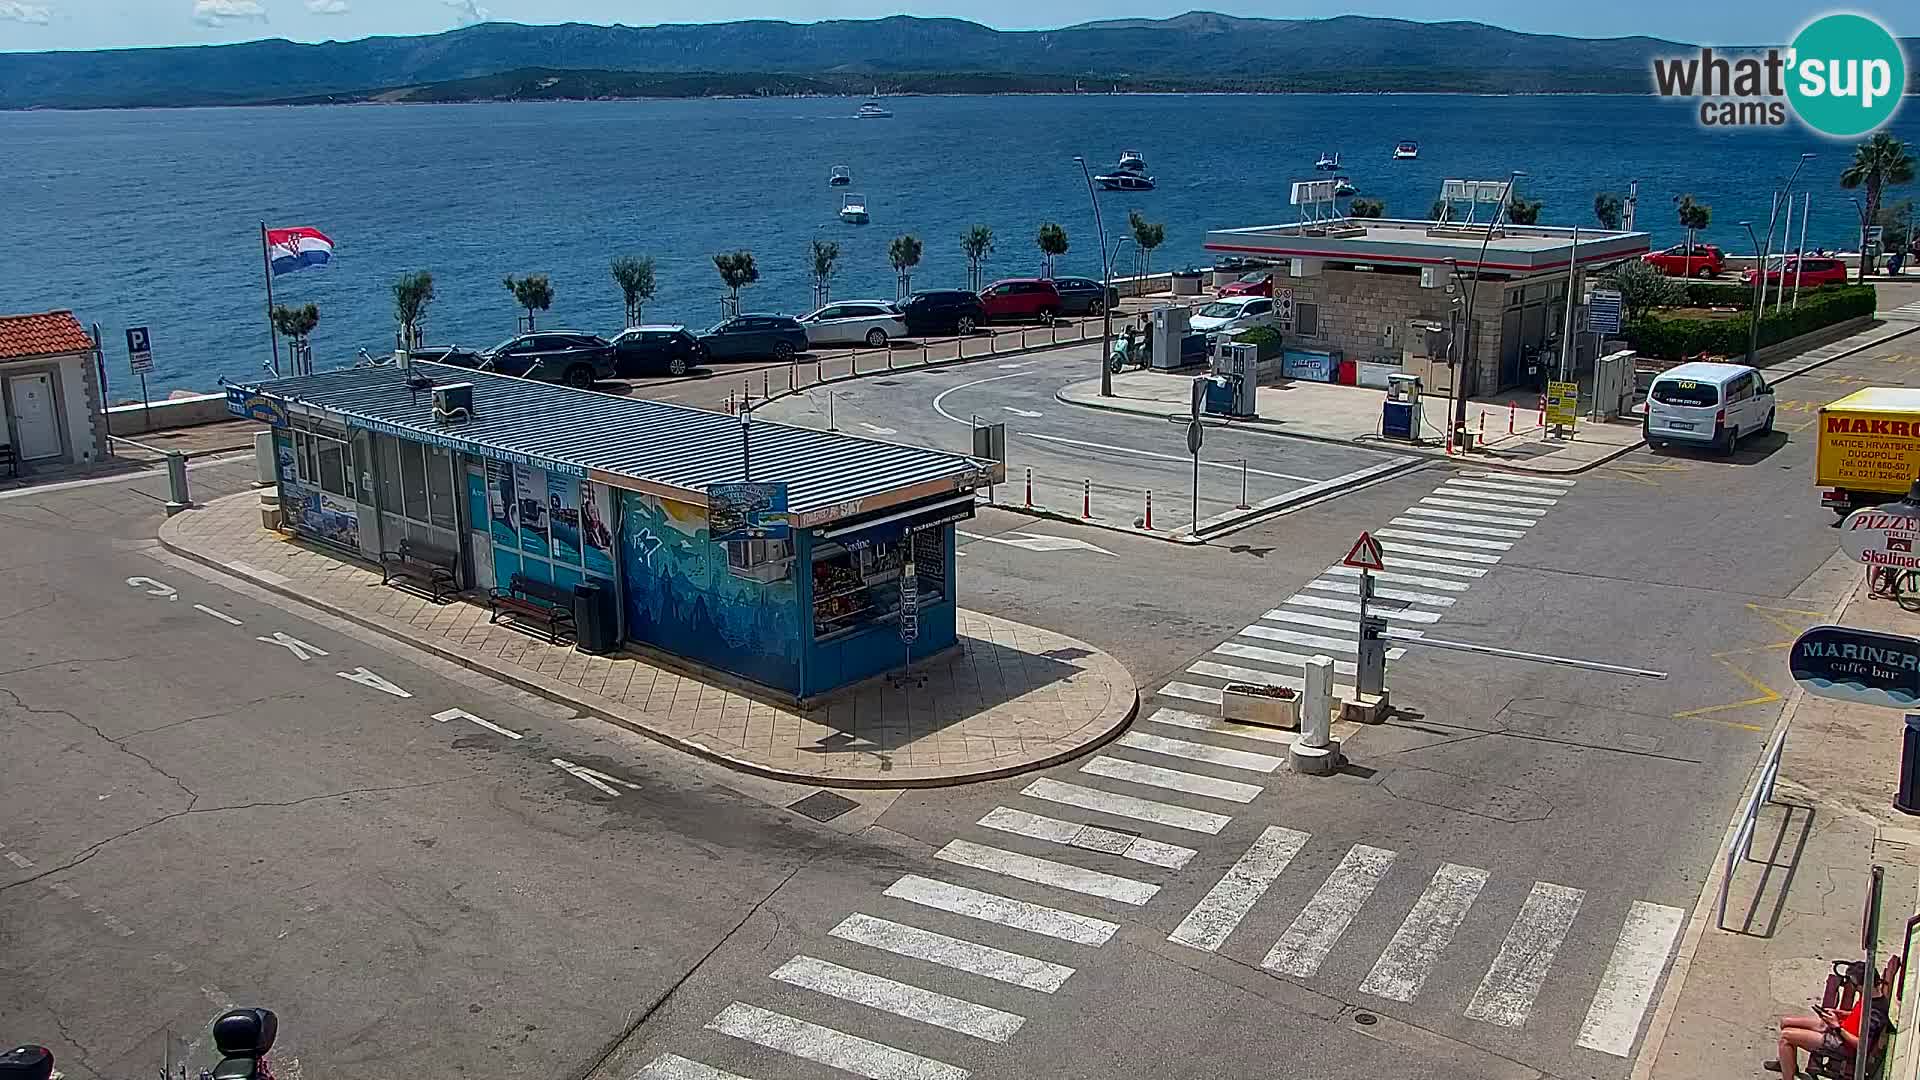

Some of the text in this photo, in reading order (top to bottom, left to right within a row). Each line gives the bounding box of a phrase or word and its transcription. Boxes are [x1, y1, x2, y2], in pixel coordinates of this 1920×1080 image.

[131, 331, 144, 349] P
[1678, 381, 1697, 389] TAXI
[397, 426, 437, 444] AUTOBUSNA
[437, 436, 469, 451] POSTAJA
[480, 446, 494, 457] BUS
[495, 448, 528, 464] STATION
[530, 455, 557, 471] TICKET
[557, 462, 584, 478] OFFICE
[1830, 439, 1864, 449] MATICE
[1866, 441, 1913, 452] HRVATSKE
[1841, 460, 1855, 468] Tel.
[1848, 450, 1904, 461] DUGOPOLJE
[1852, 514, 1920, 533] PIZZE
[1803, 642, 1920, 673] MARINER
[1830, 661, 1899, 680] caffe bar
